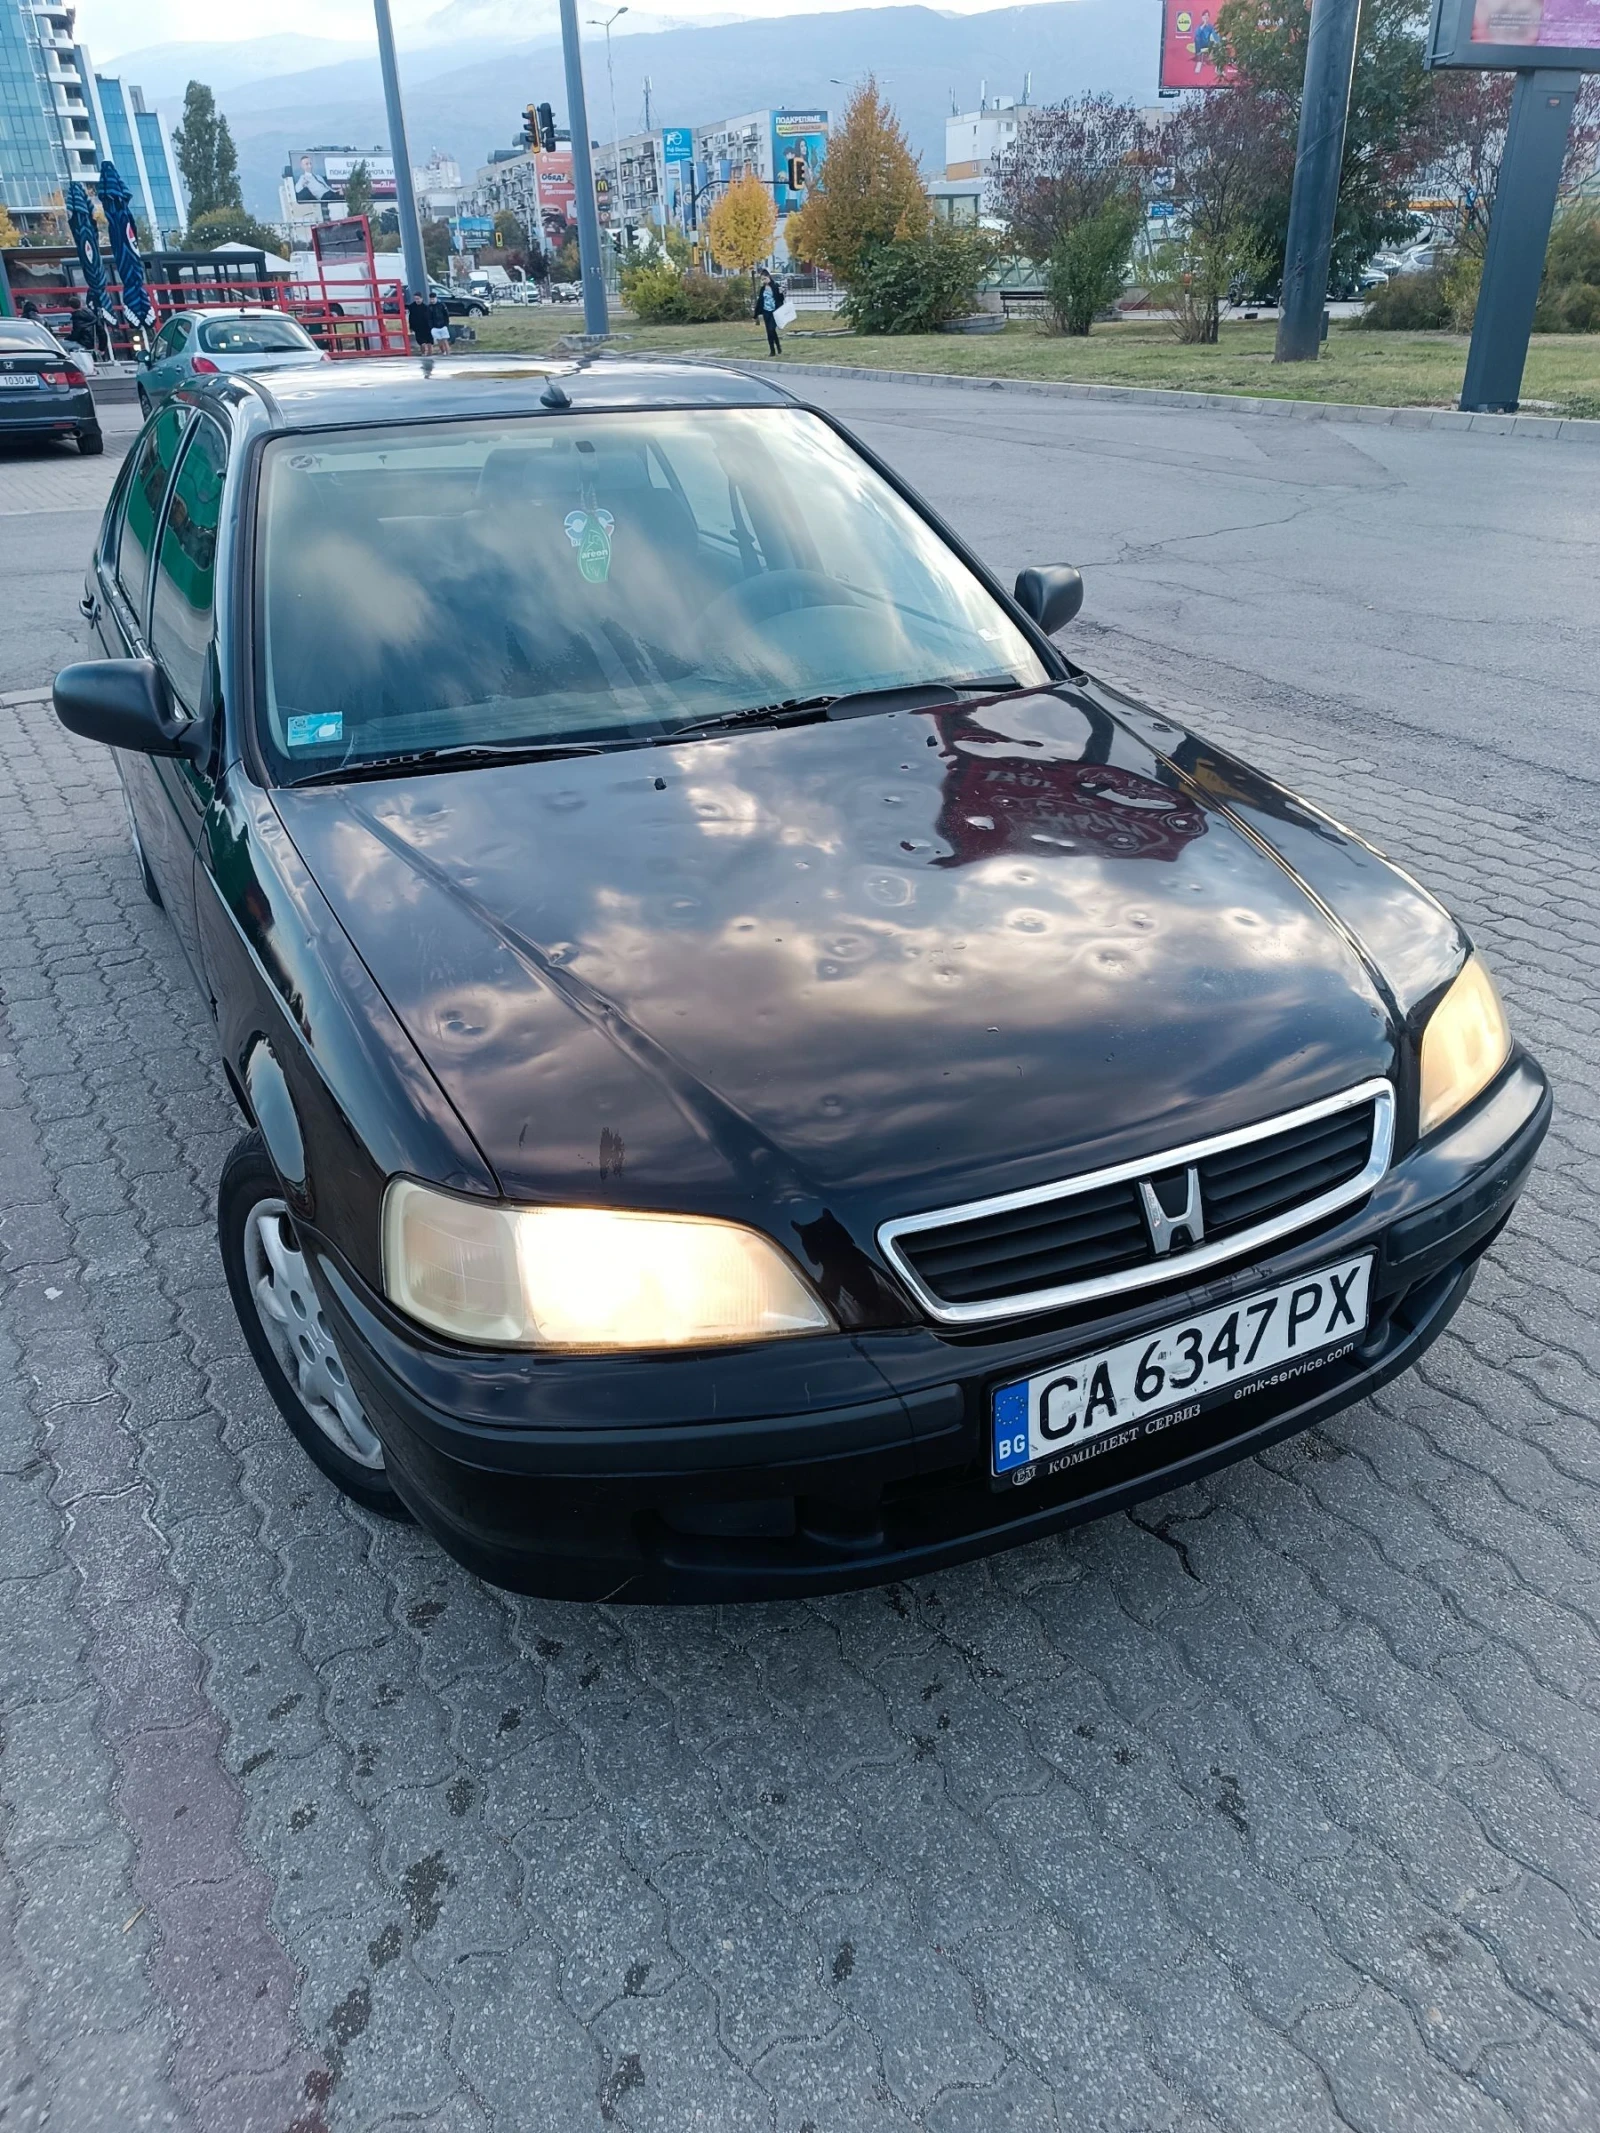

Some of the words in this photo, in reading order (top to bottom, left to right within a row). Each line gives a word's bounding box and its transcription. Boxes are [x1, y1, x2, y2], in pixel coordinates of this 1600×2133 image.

[775, 115, 821, 124] ПОДКРЕПЯМЕ
[4, 376, 24, 385] 1030
[582, 549, 609, 559] areon
[1039, 1361, 1118, 1441] CA
[1134, 1297, 1278, 1402] 6347
[1287, 1266, 1361, 1349] PX
[1234, 1342, 1355, 1400] emk-service.com
[998, 1433, 1026, 1460] BG
[1048, 1428, 1139, 1475] КОМПЛЕКТ
[1144, 1404, 1201, 1435] СЕРВИЗ
